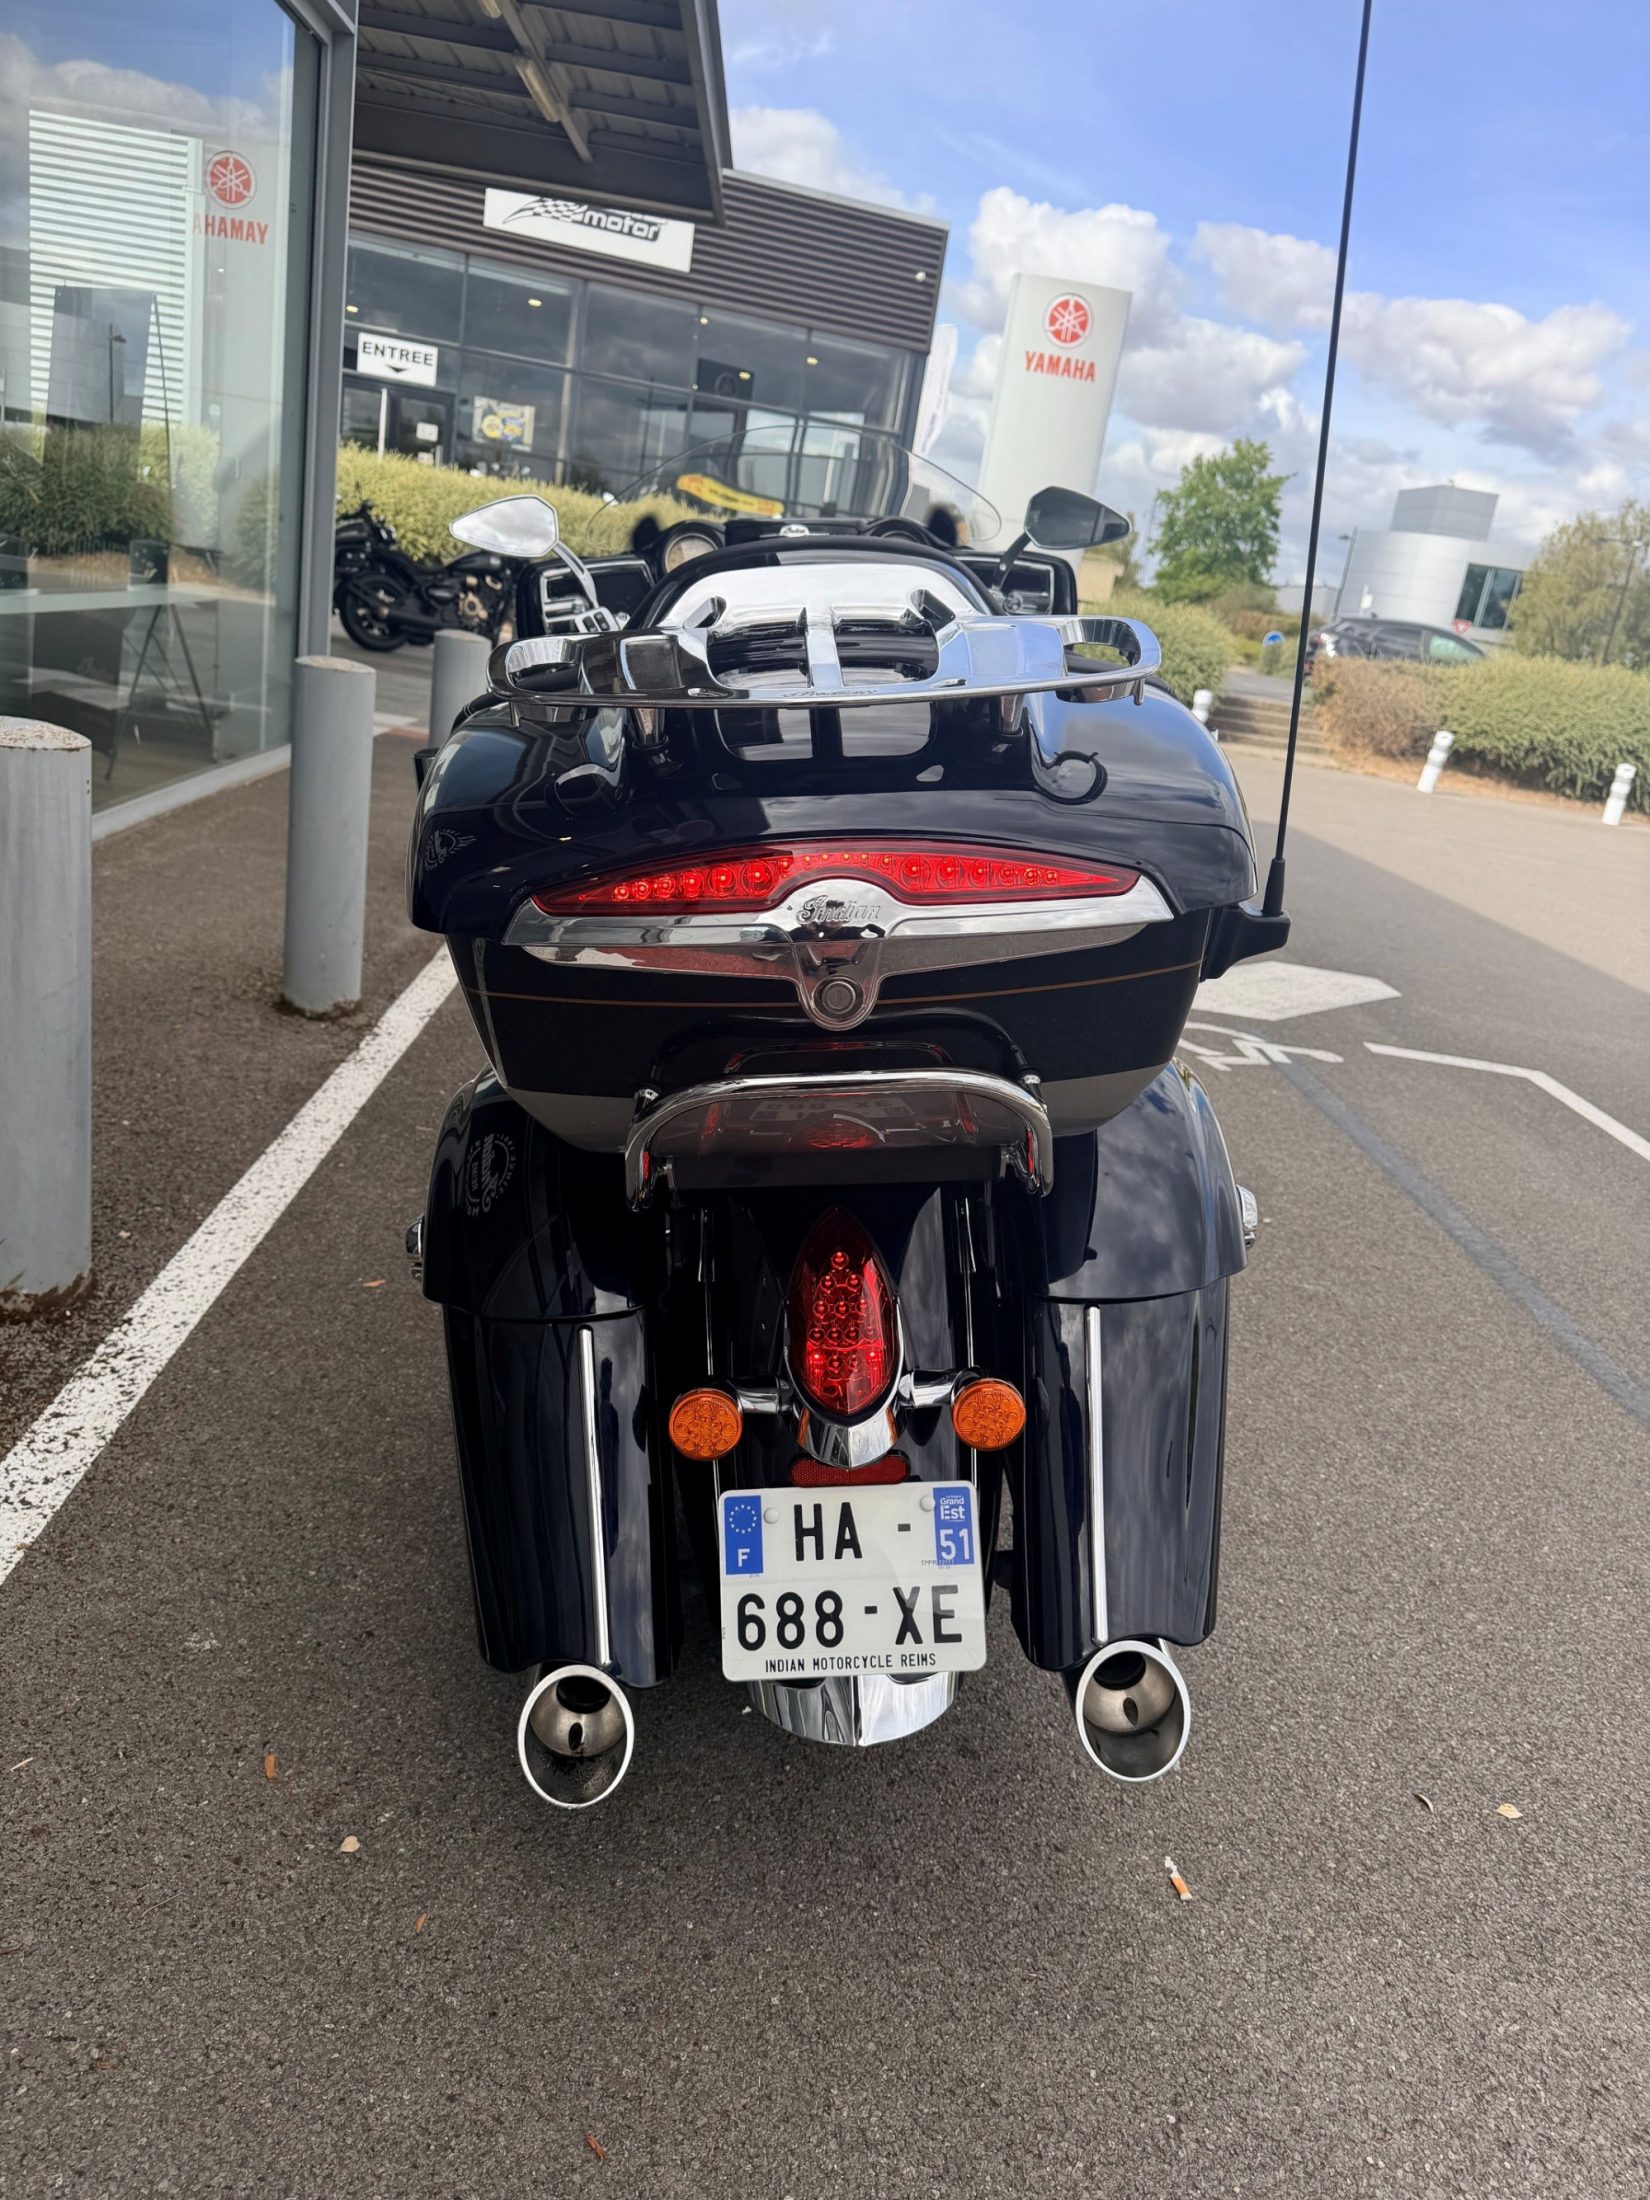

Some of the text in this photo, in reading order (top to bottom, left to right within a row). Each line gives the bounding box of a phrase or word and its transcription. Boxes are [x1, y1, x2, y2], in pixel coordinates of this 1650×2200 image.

[583, 211, 660, 240] motor
[362, 341, 434, 367] ENTREE
[1024, 350, 1097, 383] YAMAHA
[796, 895, 881, 925] Indian
[940, 1496, 965, 1505] Grand
[940, 1506, 966, 1520] Est
[793, 1502, 862, 1561] HA
[940, 1528, 970, 1560] 51
[737, 1548, 750, 1567] F
[765, 1652, 937, 1673] INDIAN MOTORCYCLE REIMS
